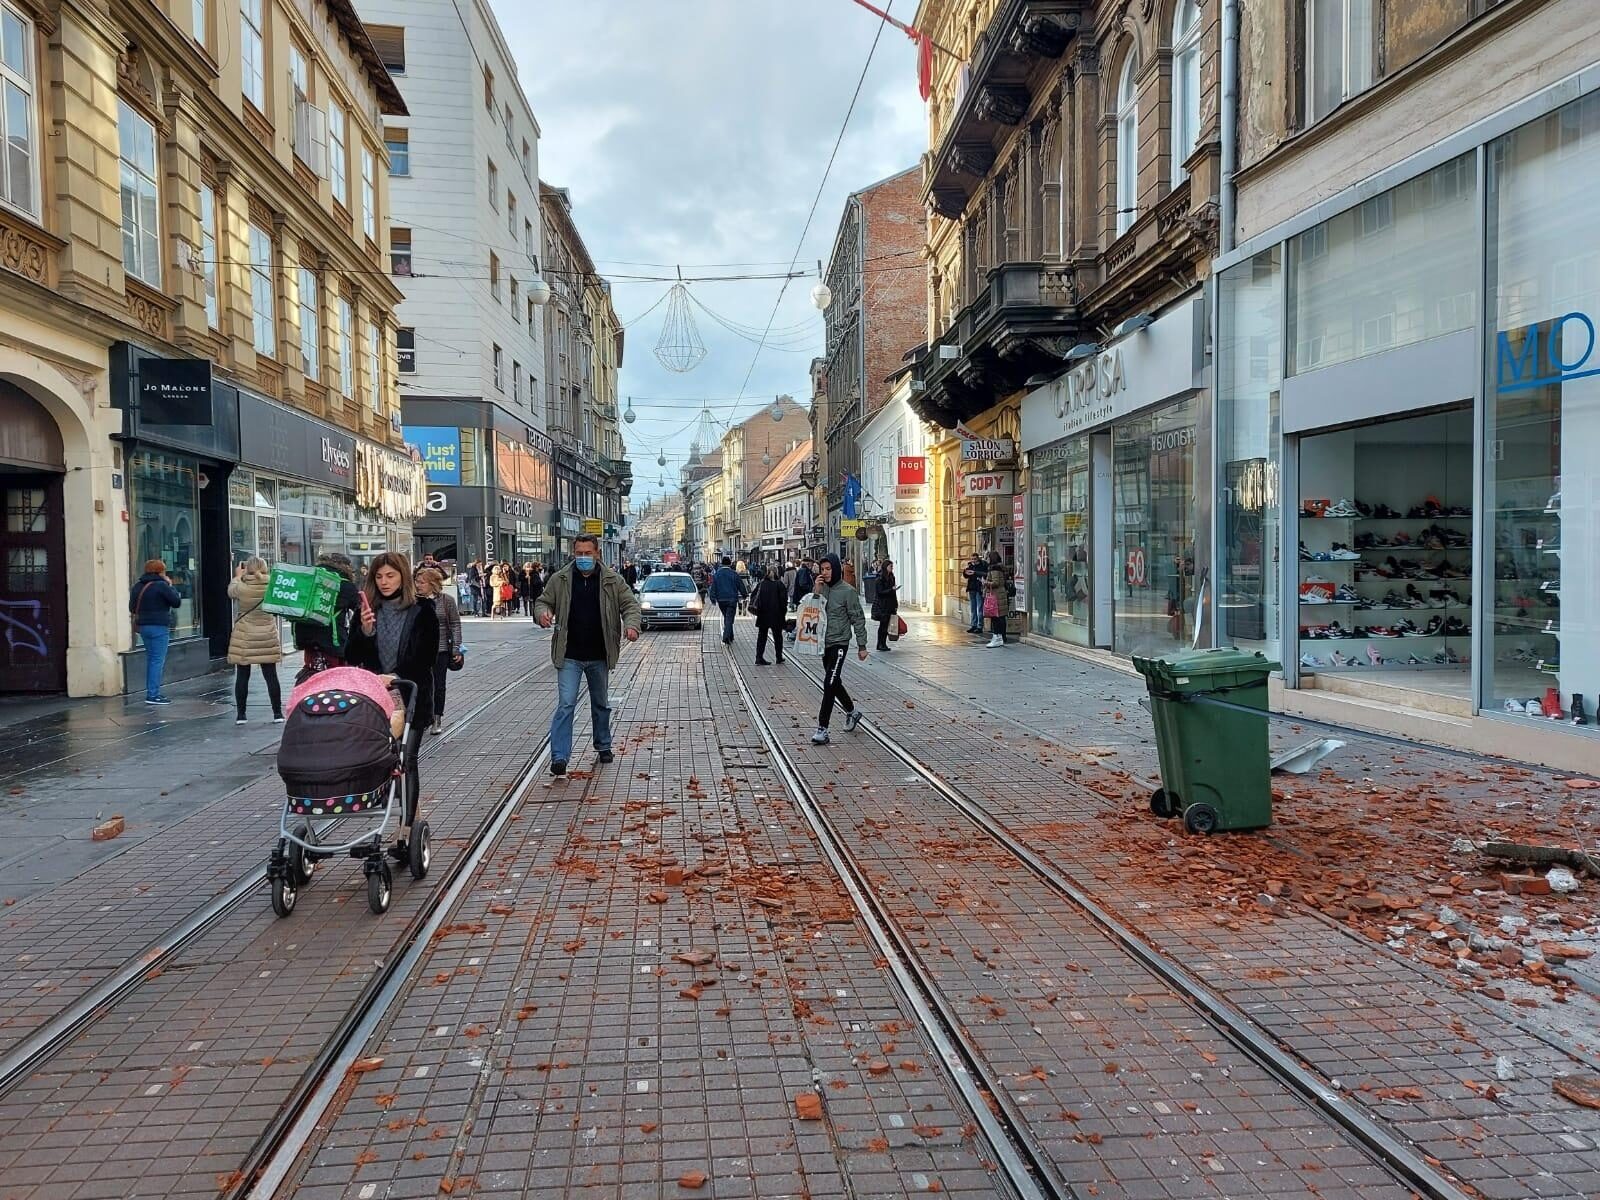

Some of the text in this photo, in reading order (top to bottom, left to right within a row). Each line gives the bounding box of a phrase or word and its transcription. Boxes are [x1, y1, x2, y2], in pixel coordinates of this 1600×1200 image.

[1497, 312, 1594, 384] MO
[1053, 348, 1126, 419] CARPISA
[425, 442, 456, 460] just
[969, 440, 1000, 450] SALON
[970, 475, 1004, 491] COPY
[275, 574, 296, 587] Bolt
[272, 587, 300, 601] Food
[805, 622, 818, 635] M
